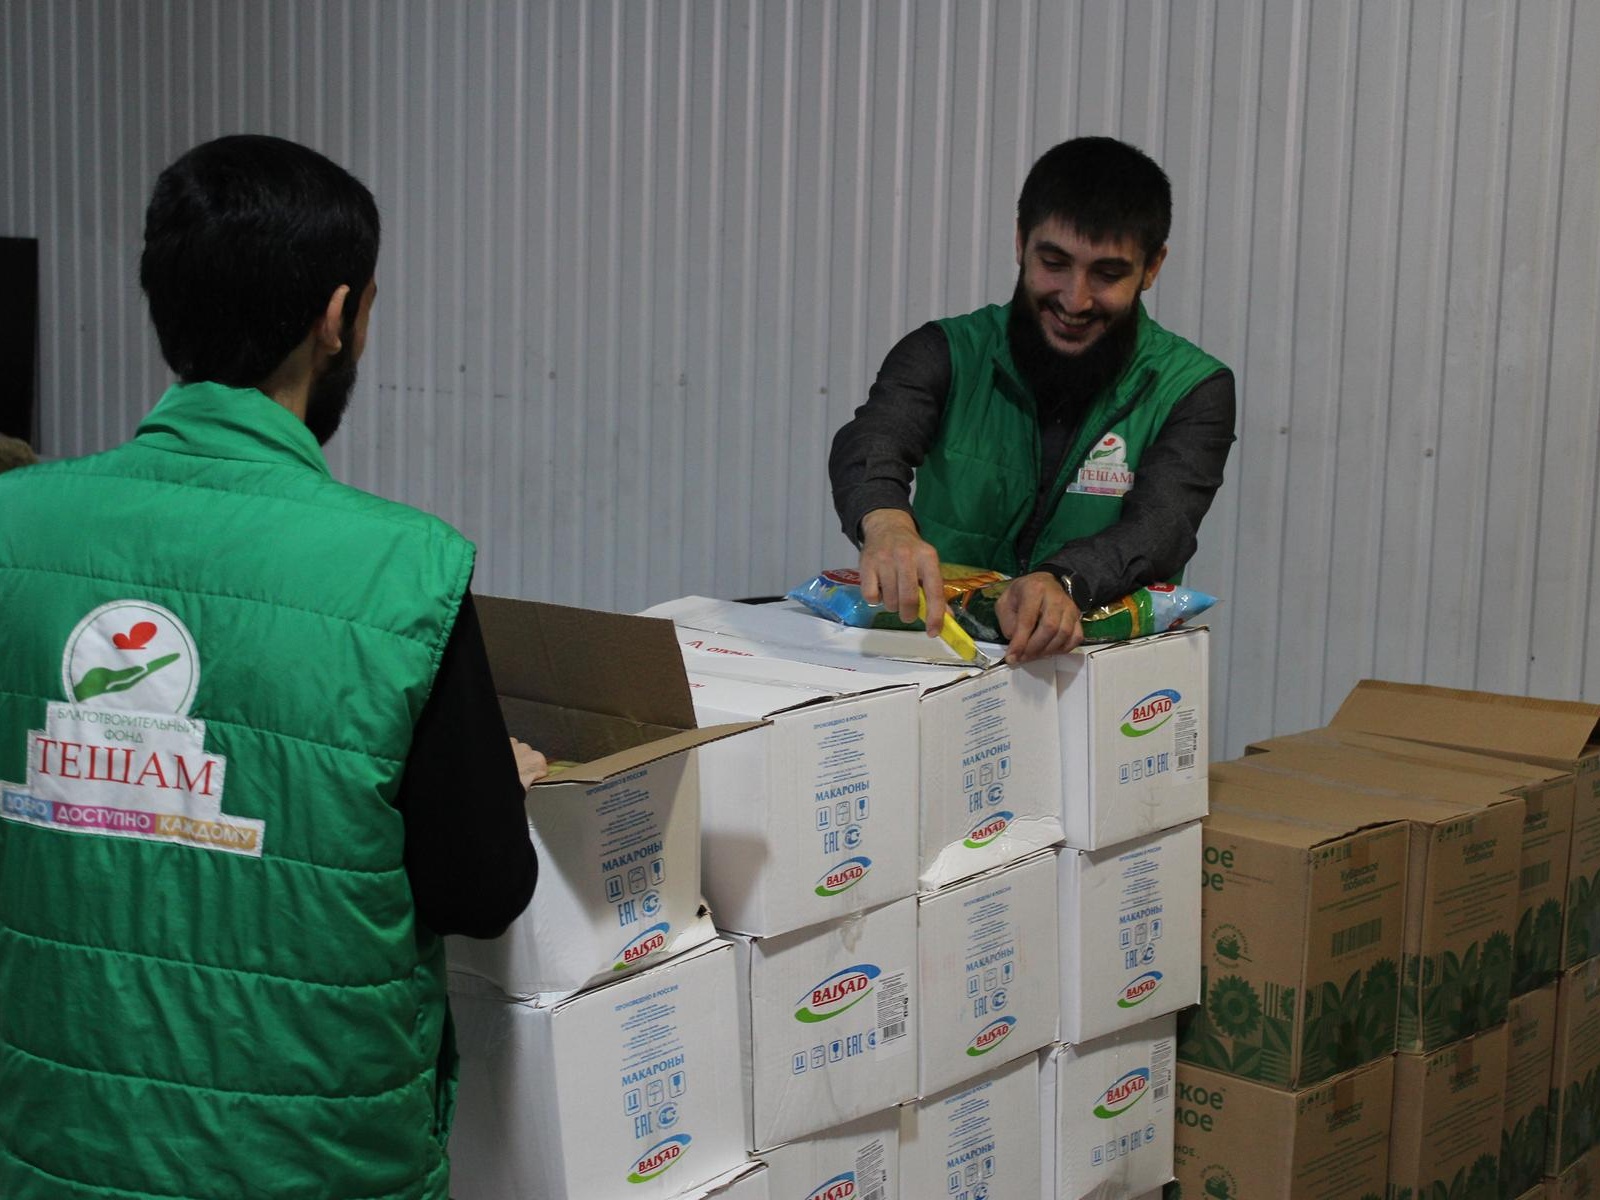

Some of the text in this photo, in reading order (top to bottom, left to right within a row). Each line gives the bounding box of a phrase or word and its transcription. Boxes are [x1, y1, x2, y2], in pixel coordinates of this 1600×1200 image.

[1081, 470, 1132, 484] ТЕШАМ
[1132, 698, 1172, 723] BAISAD
[104, 729, 144, 744] ФОНД
[36, 737, 217, 796] ТЕШАМ
[814, 781, 870, 802] МАКАРОНЫ
[57, 806, 150, 829] ДОСТУПНО
[159, 815, 251, 844] КАЖДОМУ
[602, 840, 663, 872] МАКАРОНЫ
[1203, 846, 1234, 869] ое
[826, 865, 863, 888] BAISAD
[624, 932, 664, 963] BAISAD
[812, 974, 869, 1007] BAISAD
[1126, 979, 1156, 1000] BAISAD
[976, 1024, 1010, 1048] BAISAD
[622, 1054, 685, 1087] МАКАРОНЫ
[1107, 1076, 1146, 1105] BAISAD
[1177, 1082, 1224, 1111] кое
[638, 1144, 680, 1174] BAISAD
